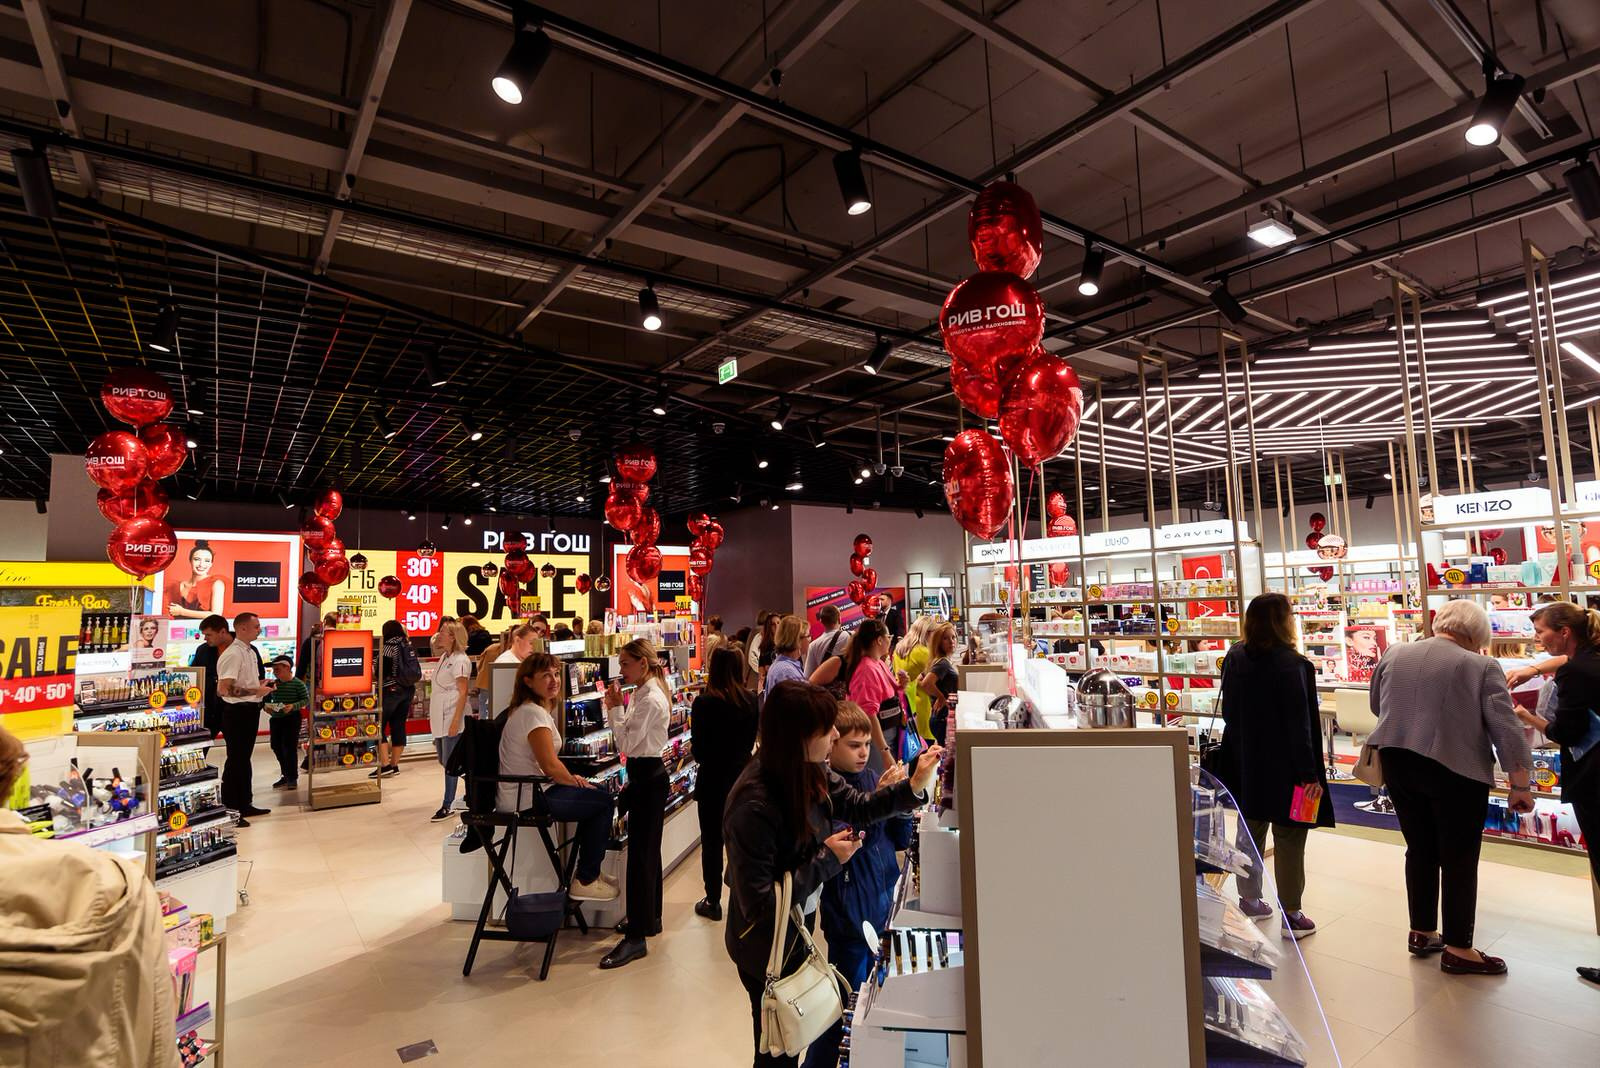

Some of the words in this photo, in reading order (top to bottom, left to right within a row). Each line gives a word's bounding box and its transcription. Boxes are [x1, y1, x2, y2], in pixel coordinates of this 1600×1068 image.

[948, 308, 982, 329] РИВ
[986, 303, 1026, 320] ГОШ
[112, 387, 138, 397] РИВ
[139, 389, 167, 400] ГОШ
[100, 456, 125, 465] ГОШ
[1456, 499, 1512, 515] KENZO
[483, 530, 535, 551] РВ
[541, 532, 590, 552] ГОШ
[1164, 528, 1223, 540] CARVEN
[125, 543, 152, 553] РИВ
[154, 544, 175, 553] ГОШ
[981, 548, 1004, 556] DKNY
[402, 557, 439, 577] -30%
[35, 594, 81, 608] Fresh
[81, 594, 111, 610] Bar
[401, 584, 438, 604] -40%
[521, 602, 541, 612] SALE
[401, 611, 438, 631] -50%
[0, 635, 80, 681] ALE
